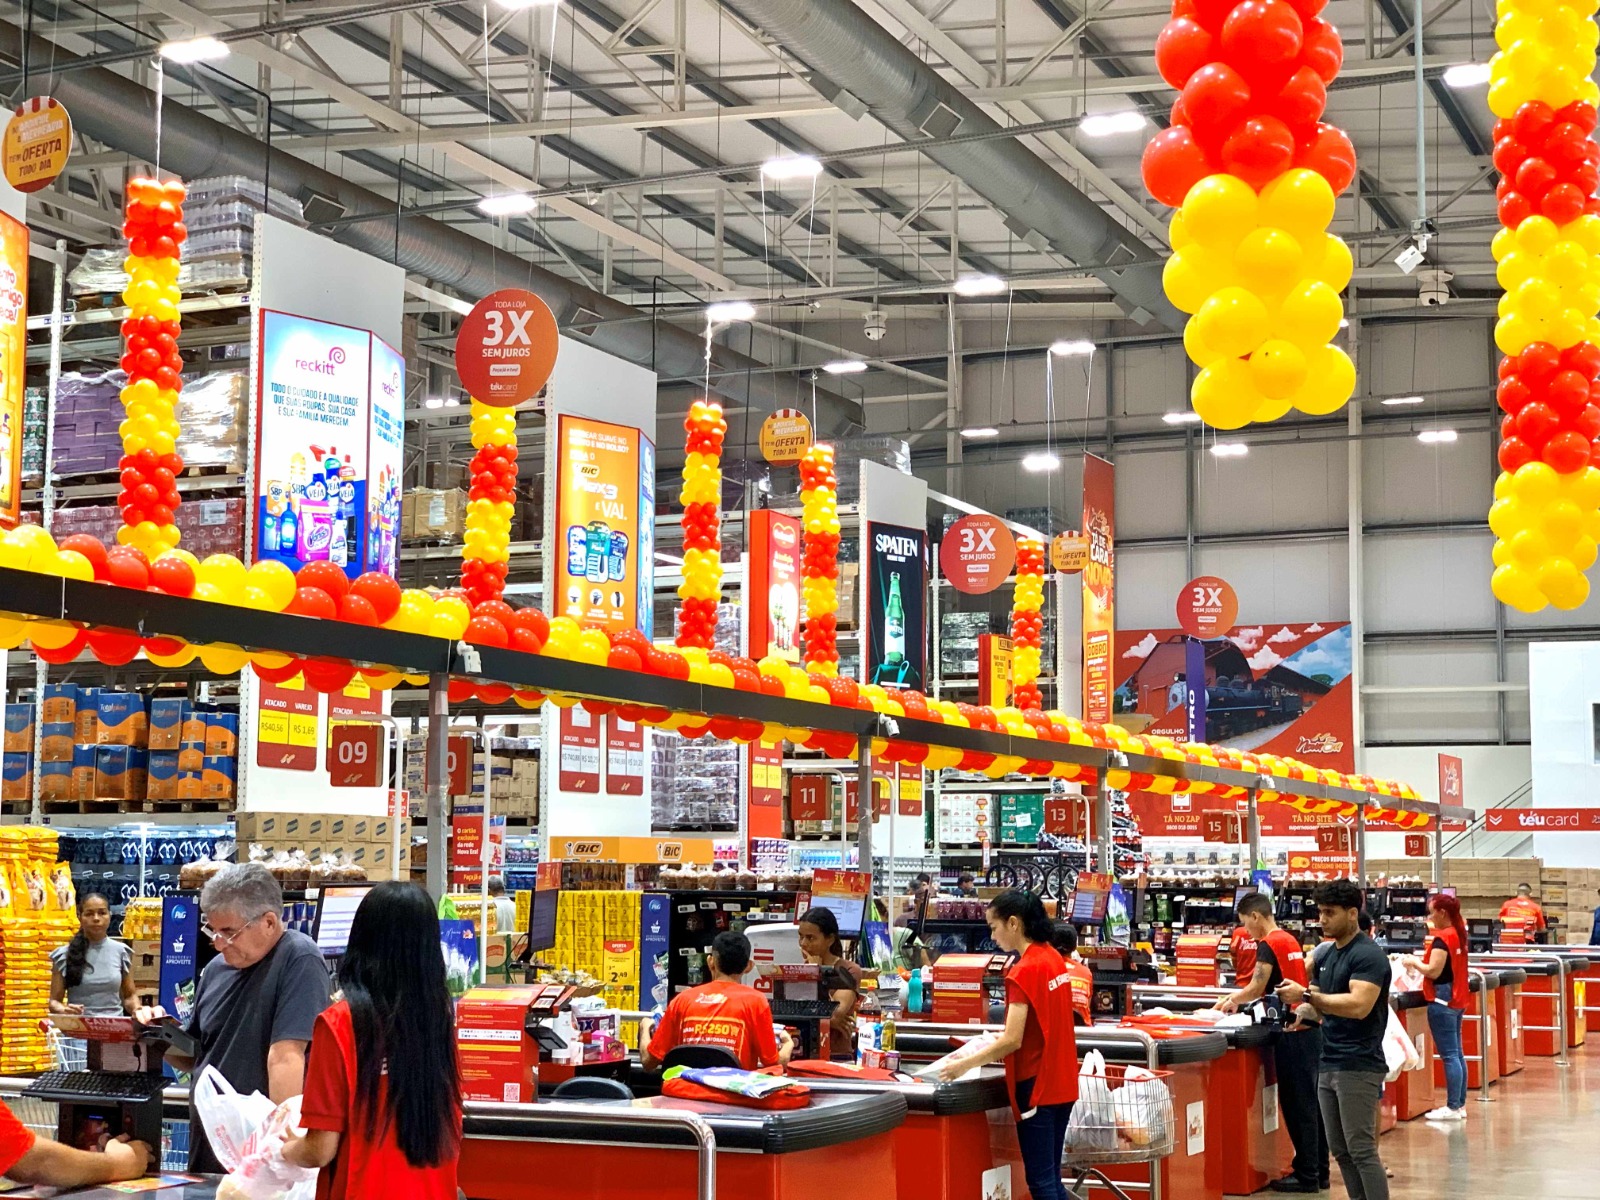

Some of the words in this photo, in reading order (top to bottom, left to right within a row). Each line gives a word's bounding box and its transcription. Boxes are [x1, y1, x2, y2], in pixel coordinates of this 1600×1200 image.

[22, 138, 62, 162] OFERTA
[19, 163, 36, 177] TODO
[39, 159, 52, 171] DIA
[512, 301, 526, 310] LOJA
[482, 310, 534, 346] 3X
[482, 348, 501, 358] SEM
[502, 348, 531, 359] JUROS
[296, 359, 335, 376] reckitt
[271, 382, 286, 394] TODO
[292, 386, 318, 400] CUIDADO
[318, 391, 322, 400] E
[324, 392, 328, 400] A
[328, 393, 359, 407] QUALIDADE
[274, 394, 284, 404] QUE
[328, 404, 339, 414] SUA
[341, 406, 356, 416] CASA
[278, 406, 282, 416] E
[320, 414, 349, 427] MERECEM
[775, 436, 805, 448] OFERTA
[788, 447, 798, 455] DIA
[270, 486, 282, 496] SBP
[292, 482, 305, 495] SBP
[308, 488, 324, 498] VEJA
[340, 488, 354, 498] VEJA
[960, 528, 996, 552] 3X
[876, 534, 918, 558] SPATEN
[975, 552, 996, 562] JUROS
[1062, 552, 1086, 560] OFERTA
[1090, 544, 1109, 567] CARA
[1192, 587, 1223, 606] 3X
[264, 698, 288, 708] ATACADO
[294, 702, 312, 712] VAREJO
[332, 706, 354, 715] ATACADO
[98, 732, 110, 741] PS
[151, 734, 162, 742] PS
[338, 740, 368, 764] 09
[448, 751, 457, 773] 0
[150, 784, 160, 792] PS
[800, 788, 816, 804] 11
[1050, 808, 1066, 821] 13
[1163, 813, 1173, 823] TÁ
[1174, 815, 1185, 823] NO
[1186, 815, 1200, 823] ZAP
[1292, 812, 1303, 822] TÁ
[1208, 821, 1222, 832] 15
[1322, 832, 1334, 842] 17
[1342, 834, 1348, 843] 8
[1408, 840, 1419, 849] 19
[174, 911, 187, 919] P&G
